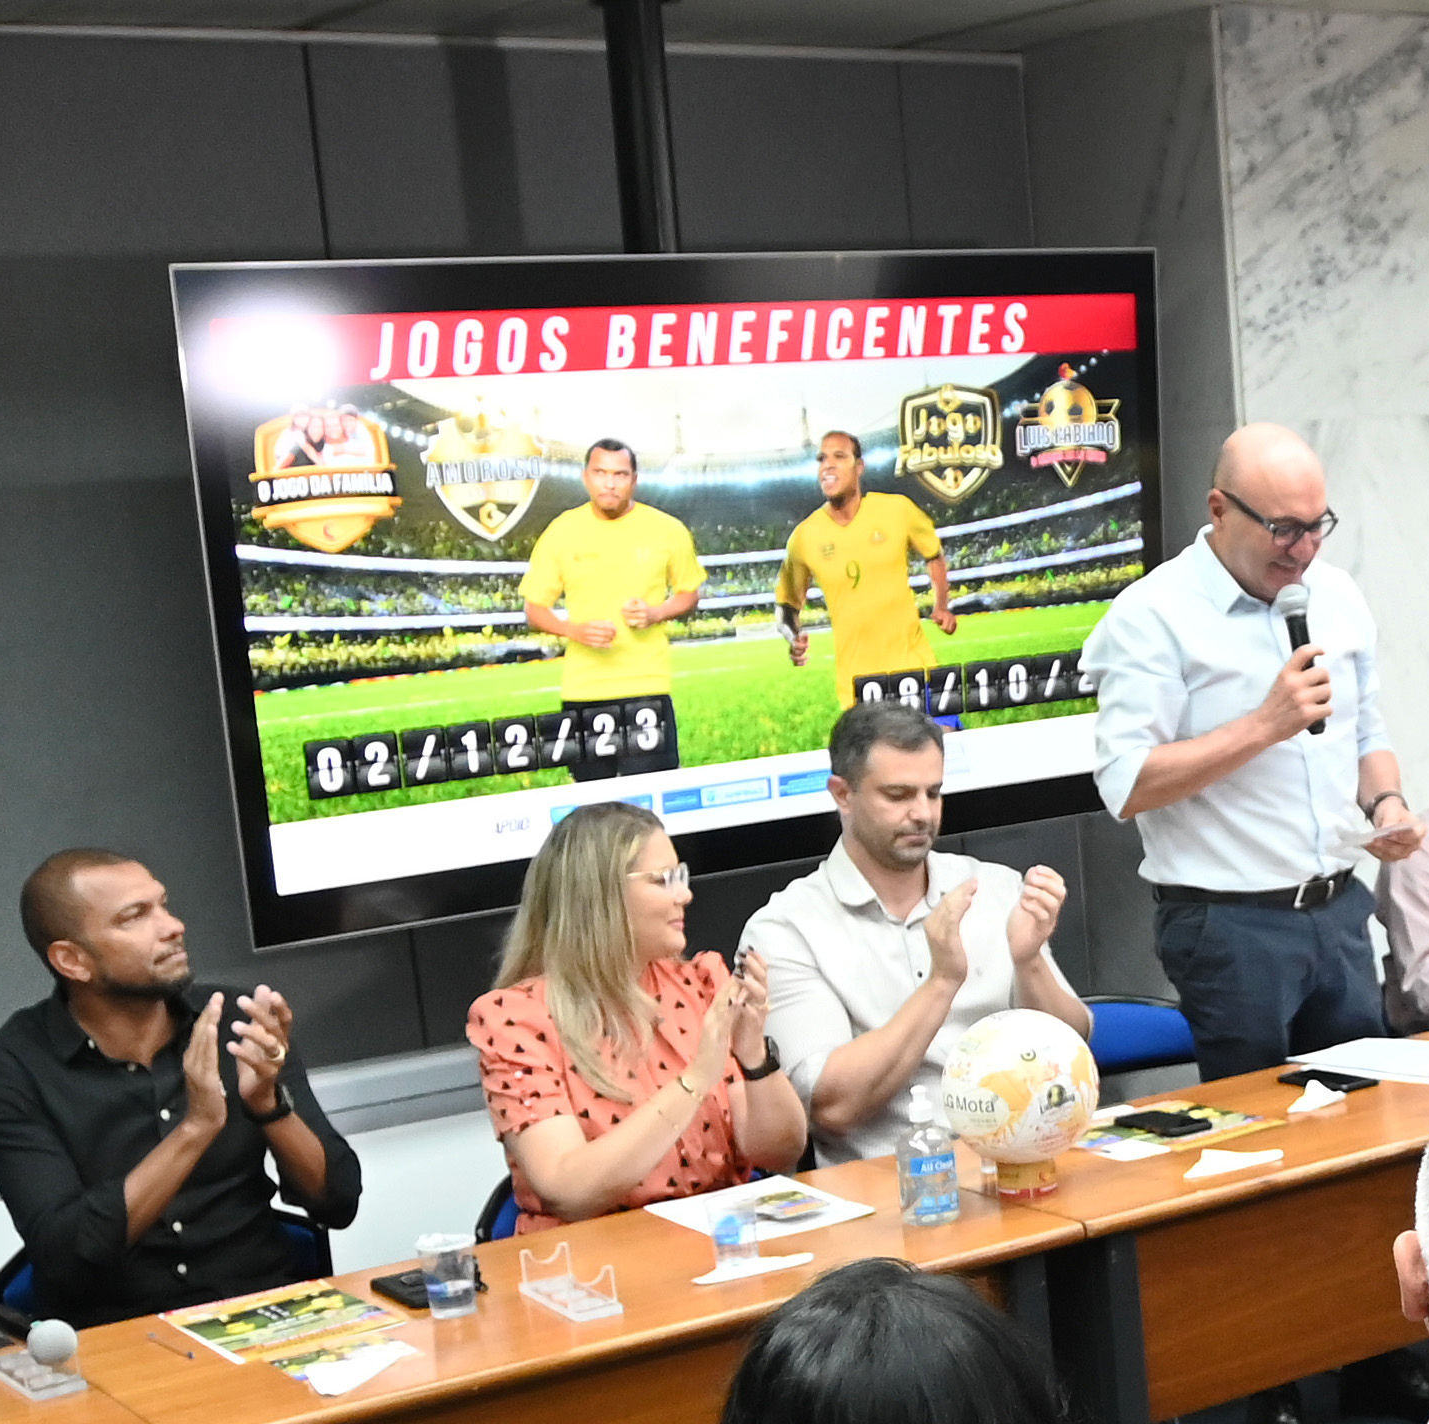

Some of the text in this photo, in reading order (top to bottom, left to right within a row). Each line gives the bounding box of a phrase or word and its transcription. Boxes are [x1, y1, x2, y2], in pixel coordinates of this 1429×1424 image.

[370, 302, 1028, 380] JOGOS BENEFICENTES
[914, 408, 981, 443] Jogo
[1018, 422, 1115, 453] LUIS FABIANO
[427, 456, 543, 487] AMOROSO
[896, 442, 1003, 476] Fabuloso
[257, 480, 271, 503] O
[272, 476, 309, 501] JOGO
[309, 474, 332, 496] DA
[317, 707, 663, 794] 02/12/23
[956, 1095, 995, 1113] Mota
